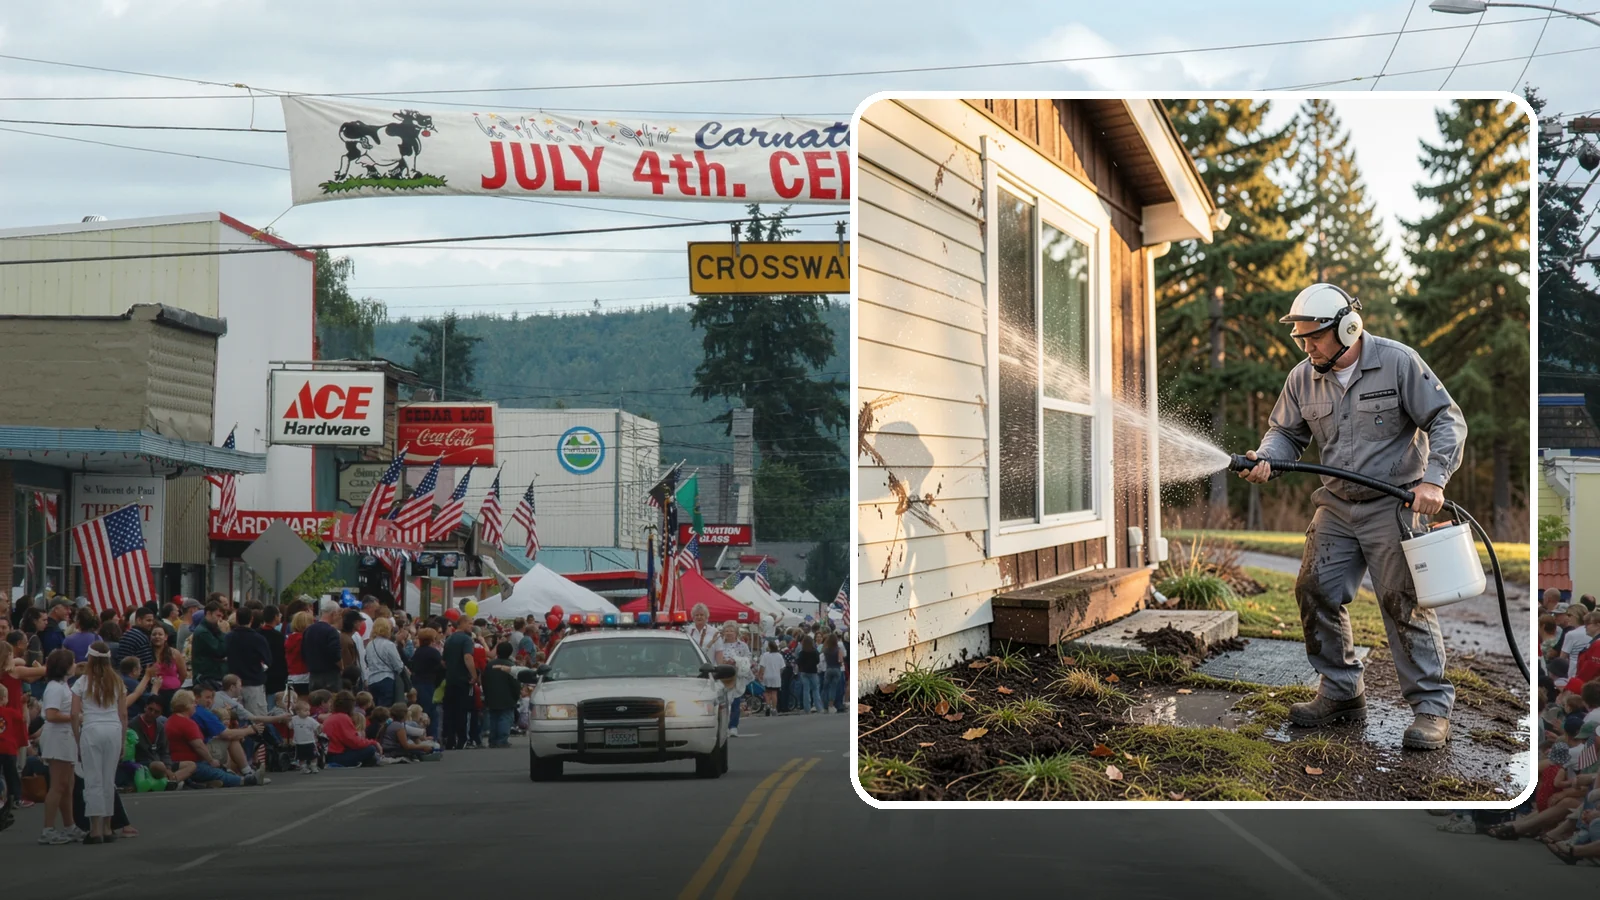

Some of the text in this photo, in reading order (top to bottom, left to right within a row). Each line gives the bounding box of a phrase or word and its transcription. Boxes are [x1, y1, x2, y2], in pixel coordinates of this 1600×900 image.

[481, 141, 604, 192] JULY
[632, 149, 746, 197] 4th.
[697, 254, 850, 280] CROSSWA
[282, 380, 373, 420] ACE
[405, 409, 485, 422] CEDAR LOG
[283, 421, 371, 436] Hardware
[353, 467, 385, 480] Simpl
[95, 485, 124, 495] Vincent
[126, 486, 136, 495] de
[137, 486, 155, 495] Paul
[688, 526, 742, 535] CRNATION
[699, 535, 730, 543] GLASS
